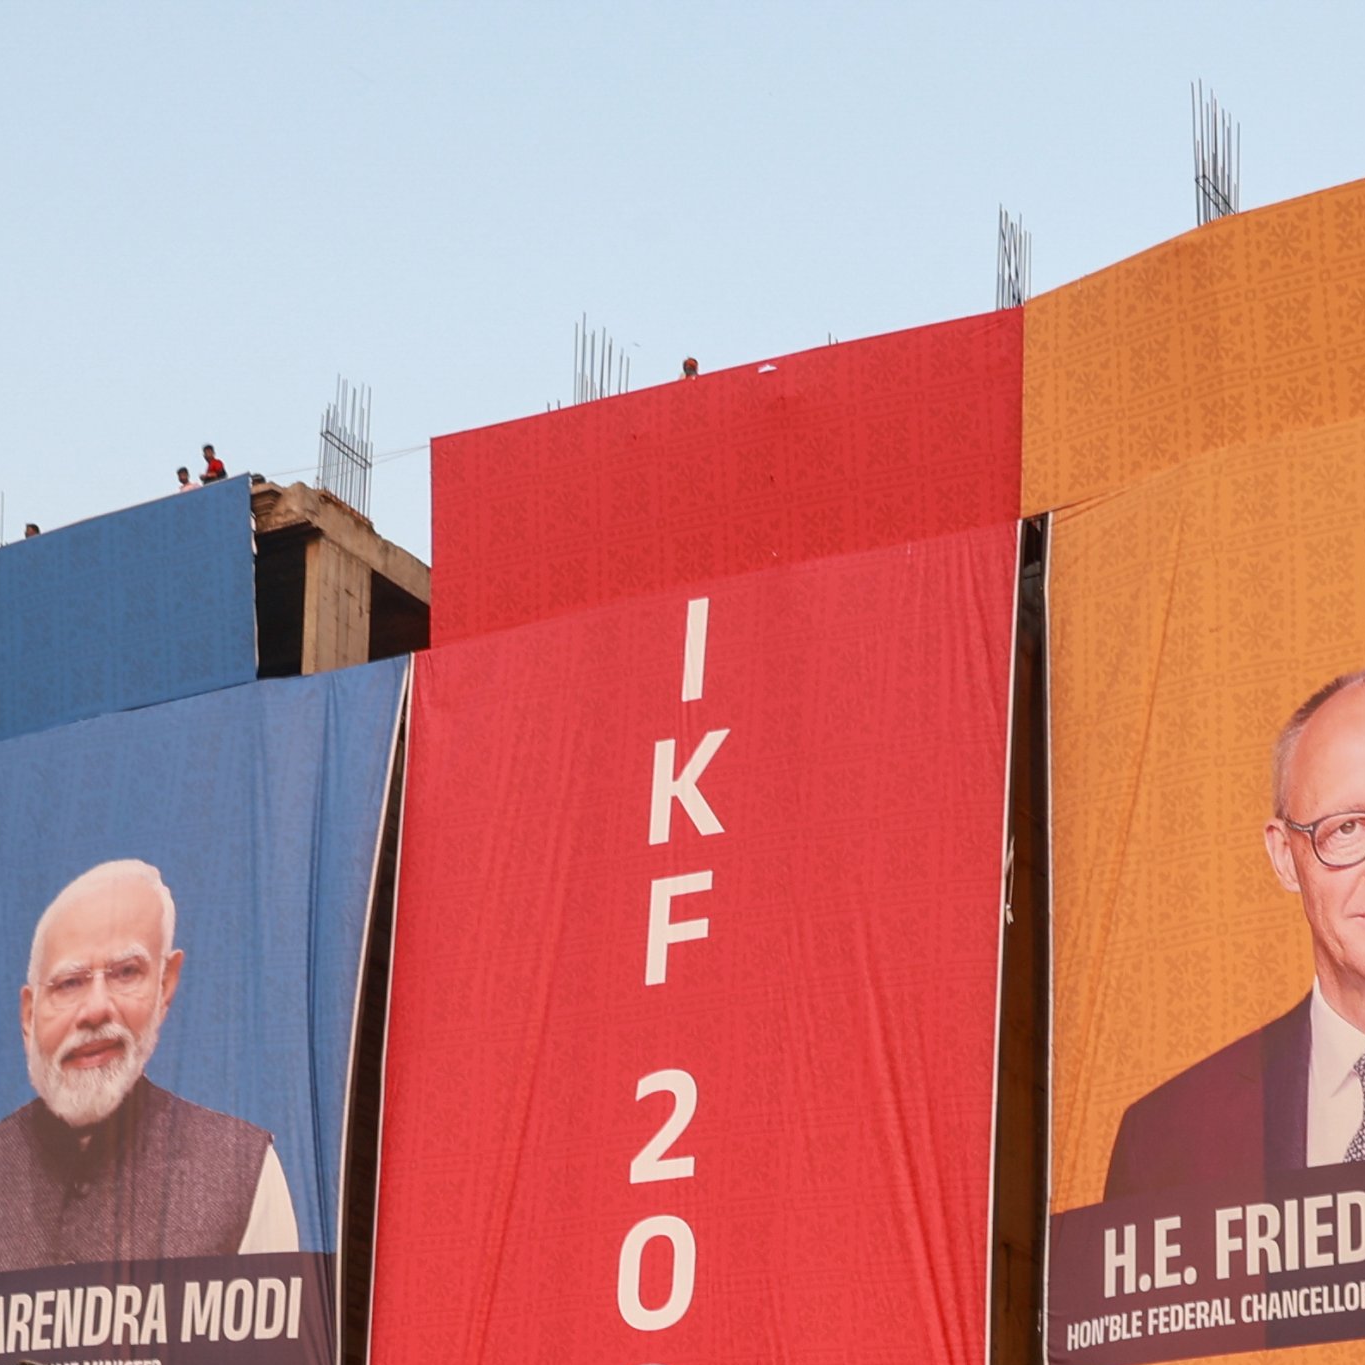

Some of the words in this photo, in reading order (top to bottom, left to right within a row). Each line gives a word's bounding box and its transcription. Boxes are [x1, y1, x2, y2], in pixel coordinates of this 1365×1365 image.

[645, 596, 731, 987] IKF
[1103, 1216, 1197, 1299] H.E.
[181, 1276, 303, 1343] MODI
[1067, 1310, 1143, 1351] HON'BLE
[1148, 1298, 1236, 1336] FEDERAL
